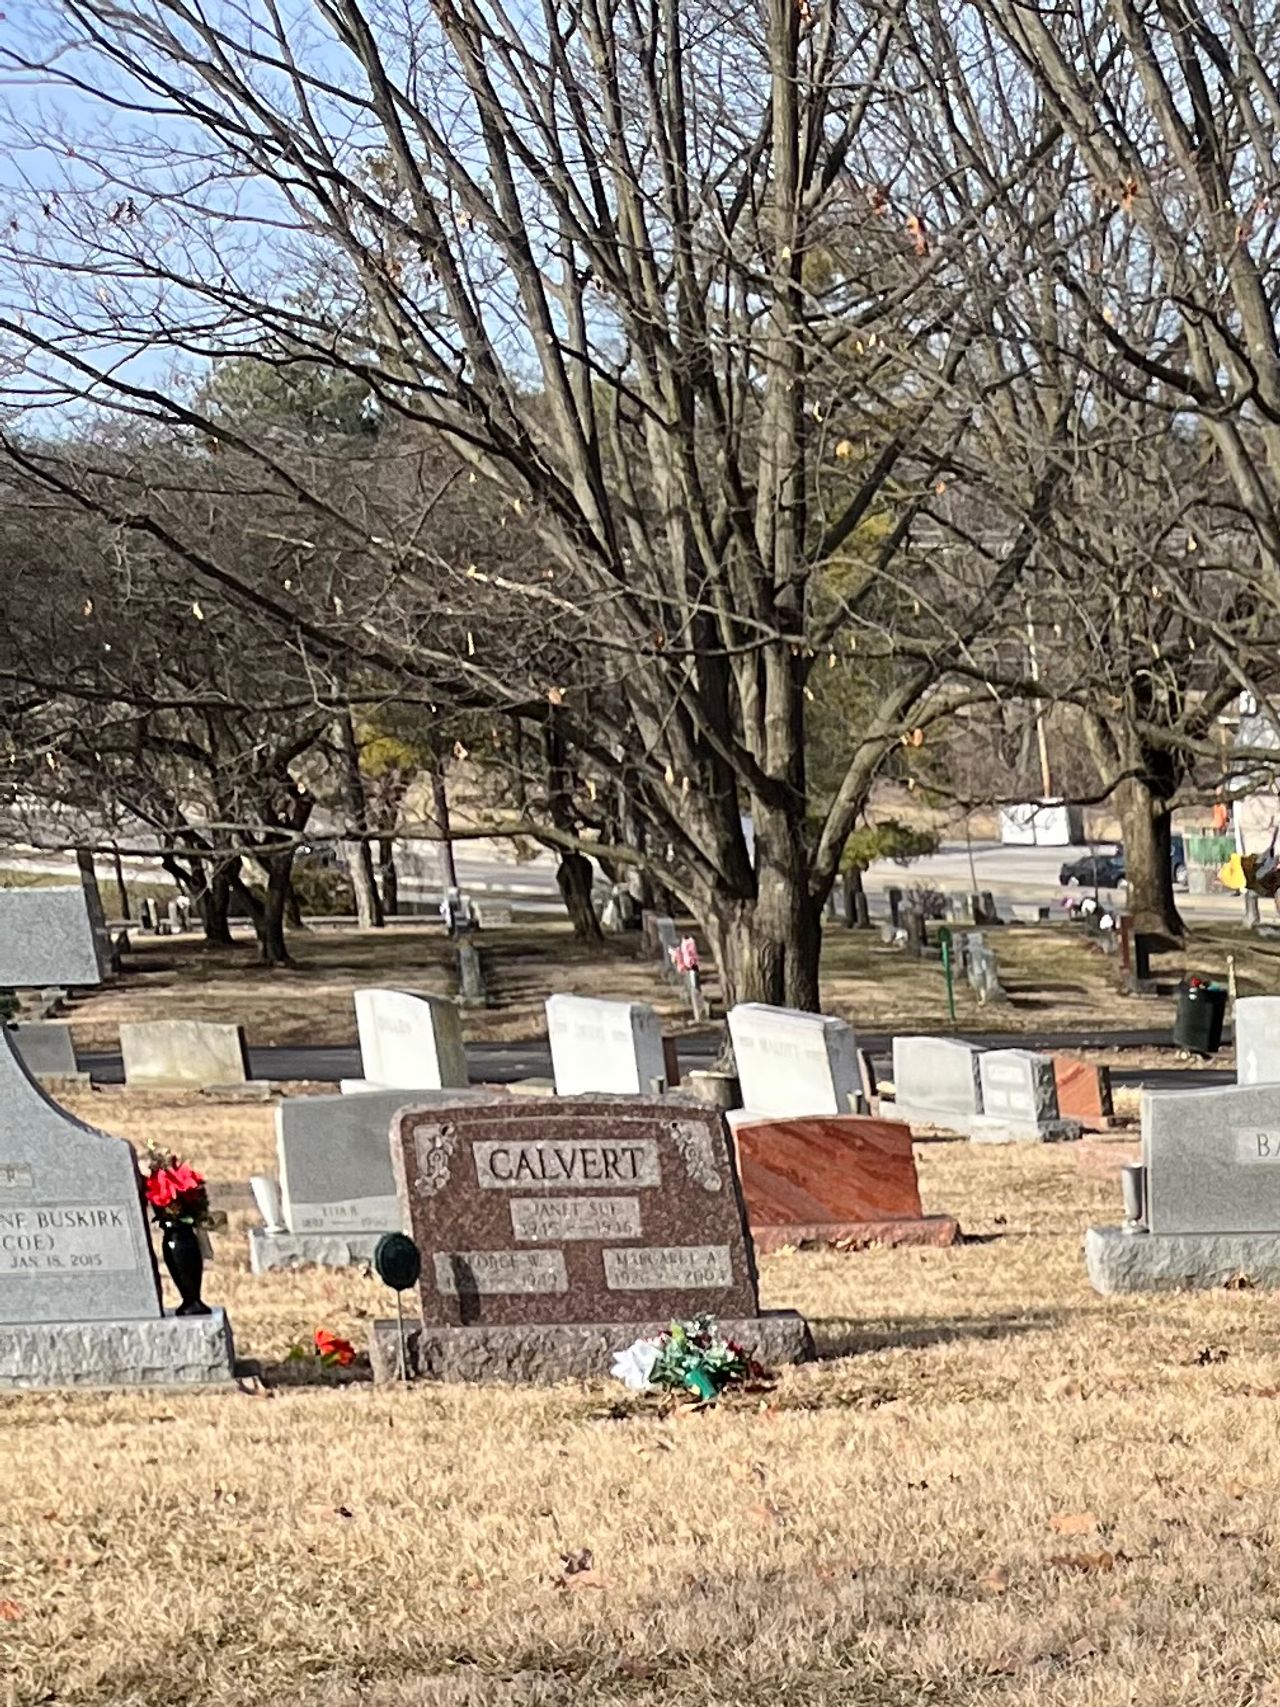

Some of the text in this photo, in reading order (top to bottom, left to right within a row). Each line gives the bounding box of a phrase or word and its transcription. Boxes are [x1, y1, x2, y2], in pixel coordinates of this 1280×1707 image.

[488, 1148, 645, 1181] CALVERT
[37, 1209, 123, 1229] BUSKIRK
[70, 1253, 103, 1267] 2015
